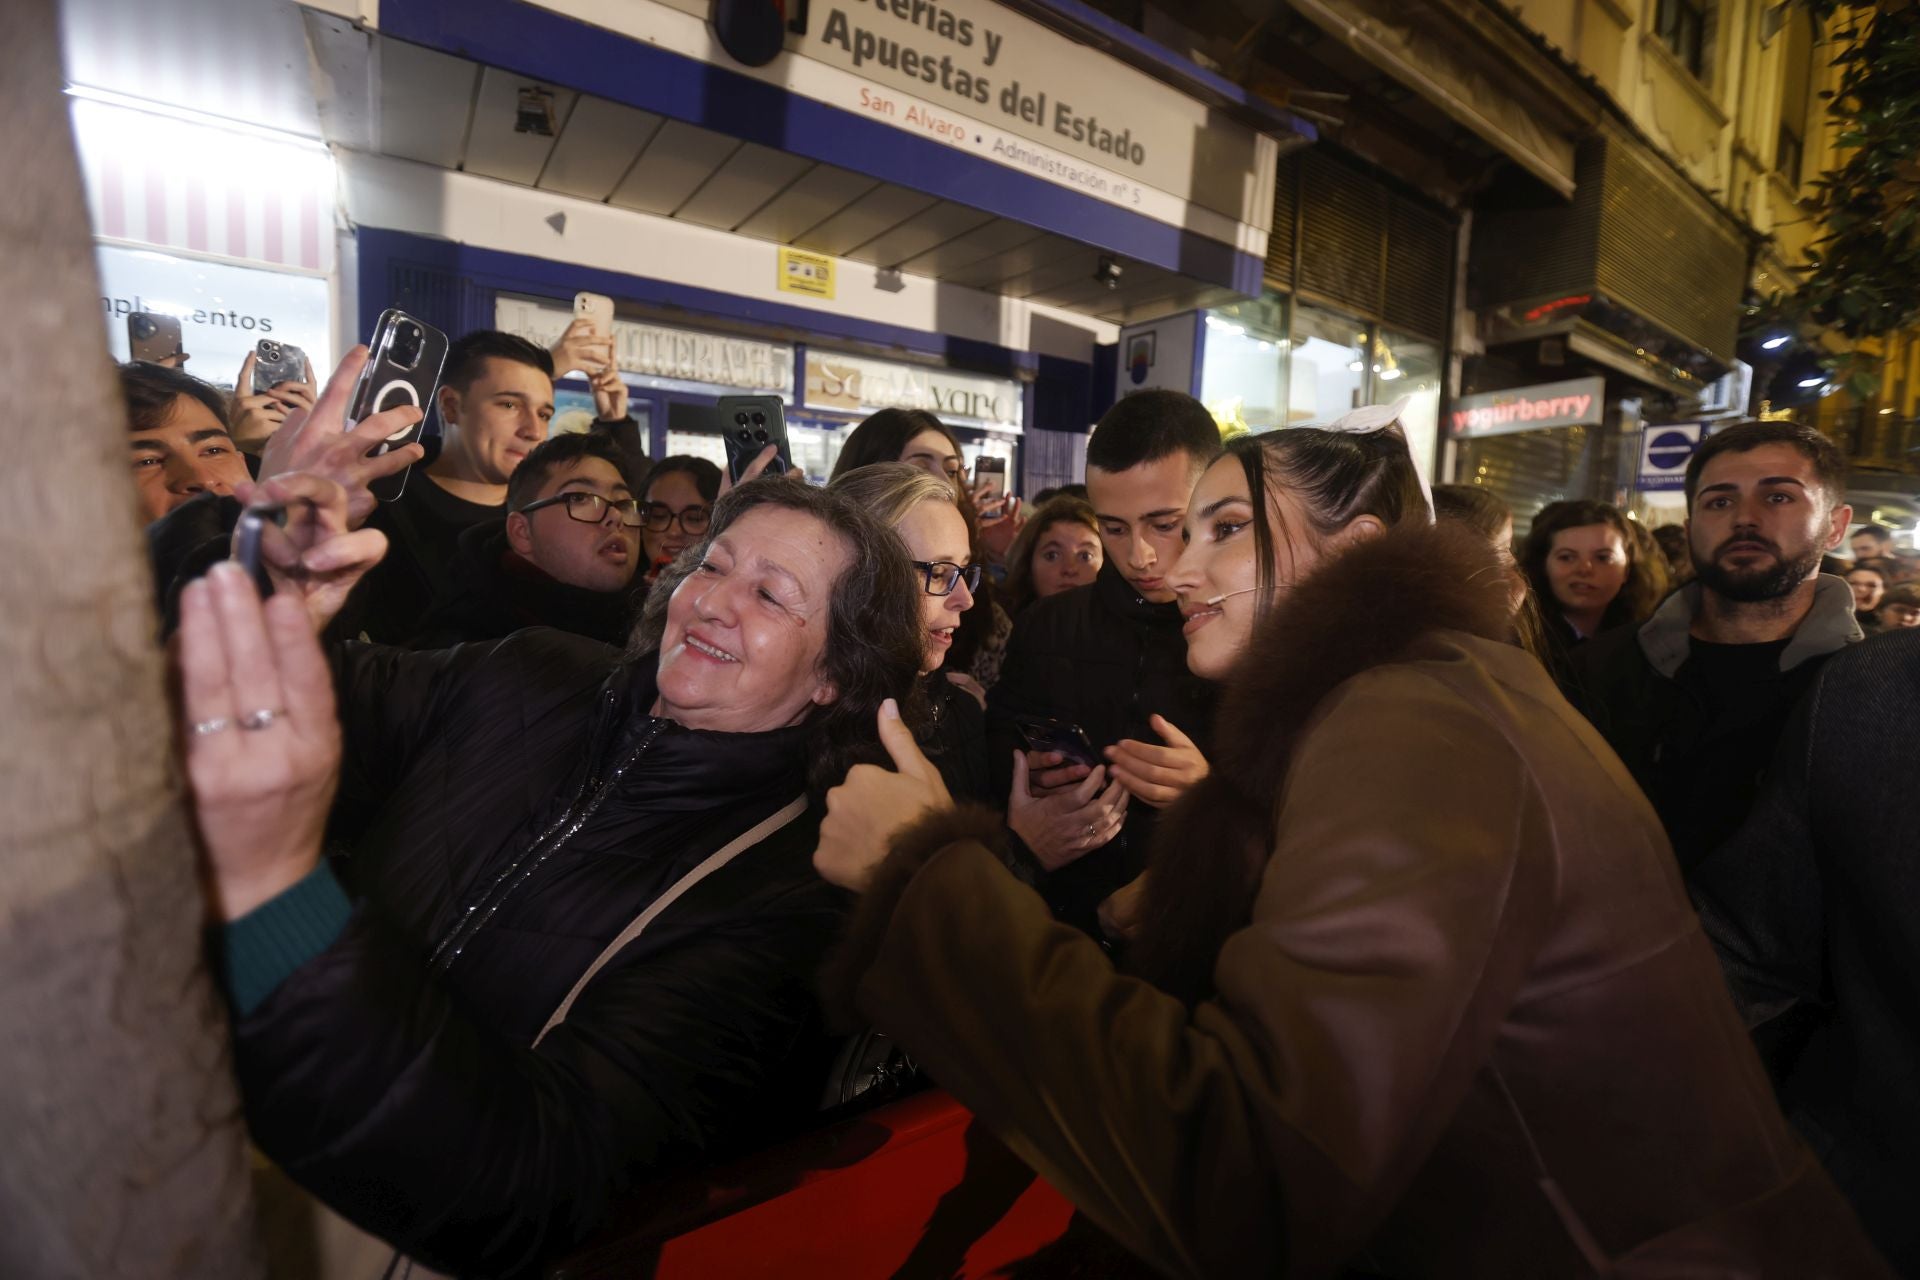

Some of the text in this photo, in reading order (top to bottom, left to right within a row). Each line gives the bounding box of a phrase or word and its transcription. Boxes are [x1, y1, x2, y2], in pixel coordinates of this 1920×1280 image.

[983, 29, 1002, 66] y
[821, 8, 1145, 166] Apuestas del Estado
[860, 87, 896, 116] San
[904, 104, 965, 140] Alvaro
[991, 135, 1107, 191] Administración
[1132, 188, 1142, 205] 5
[1452, 394, 1592, 432] yogurberry
